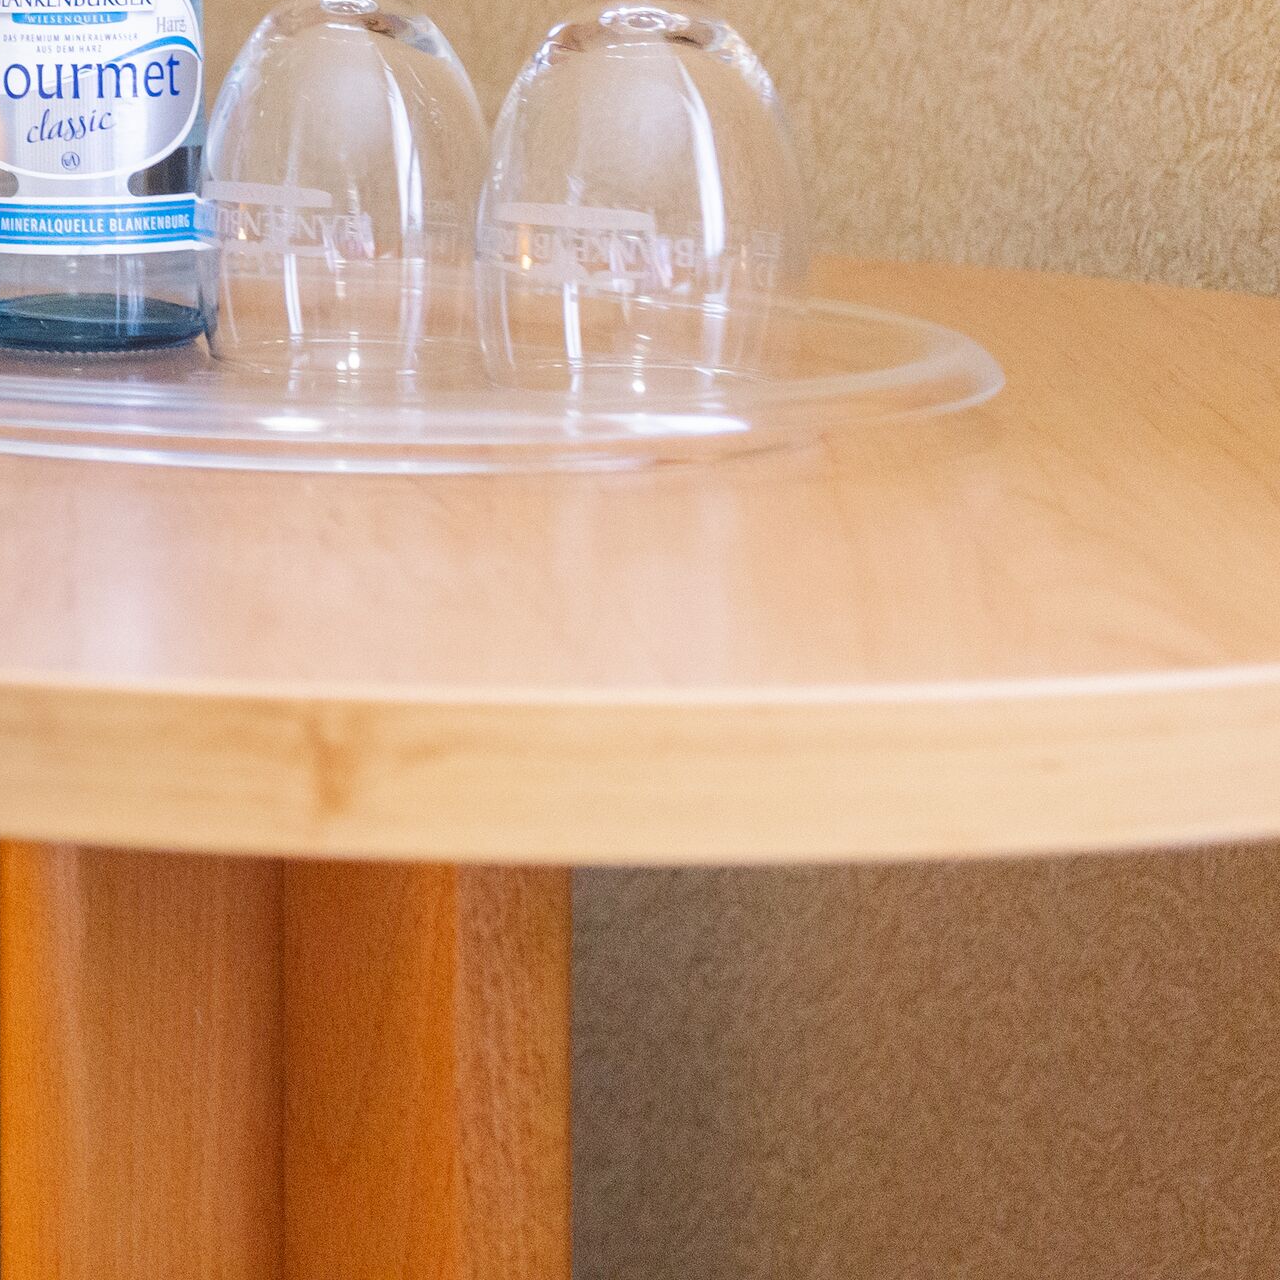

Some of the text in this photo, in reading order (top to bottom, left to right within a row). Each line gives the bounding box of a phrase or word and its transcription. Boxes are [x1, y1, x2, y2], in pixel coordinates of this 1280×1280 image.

[26, 12, 113, 25] WIESENQUELL
[2, 32, 138, 43] DAS PREMIUM MINERALWASSER
[36, 44, 102, 54] AUS DEM HARZ
[26, 108, 117, 144] classic
[0, 217, 104, 235] MINERALQUELLE
[108, 212, 191, 233] BLANKENBURG
